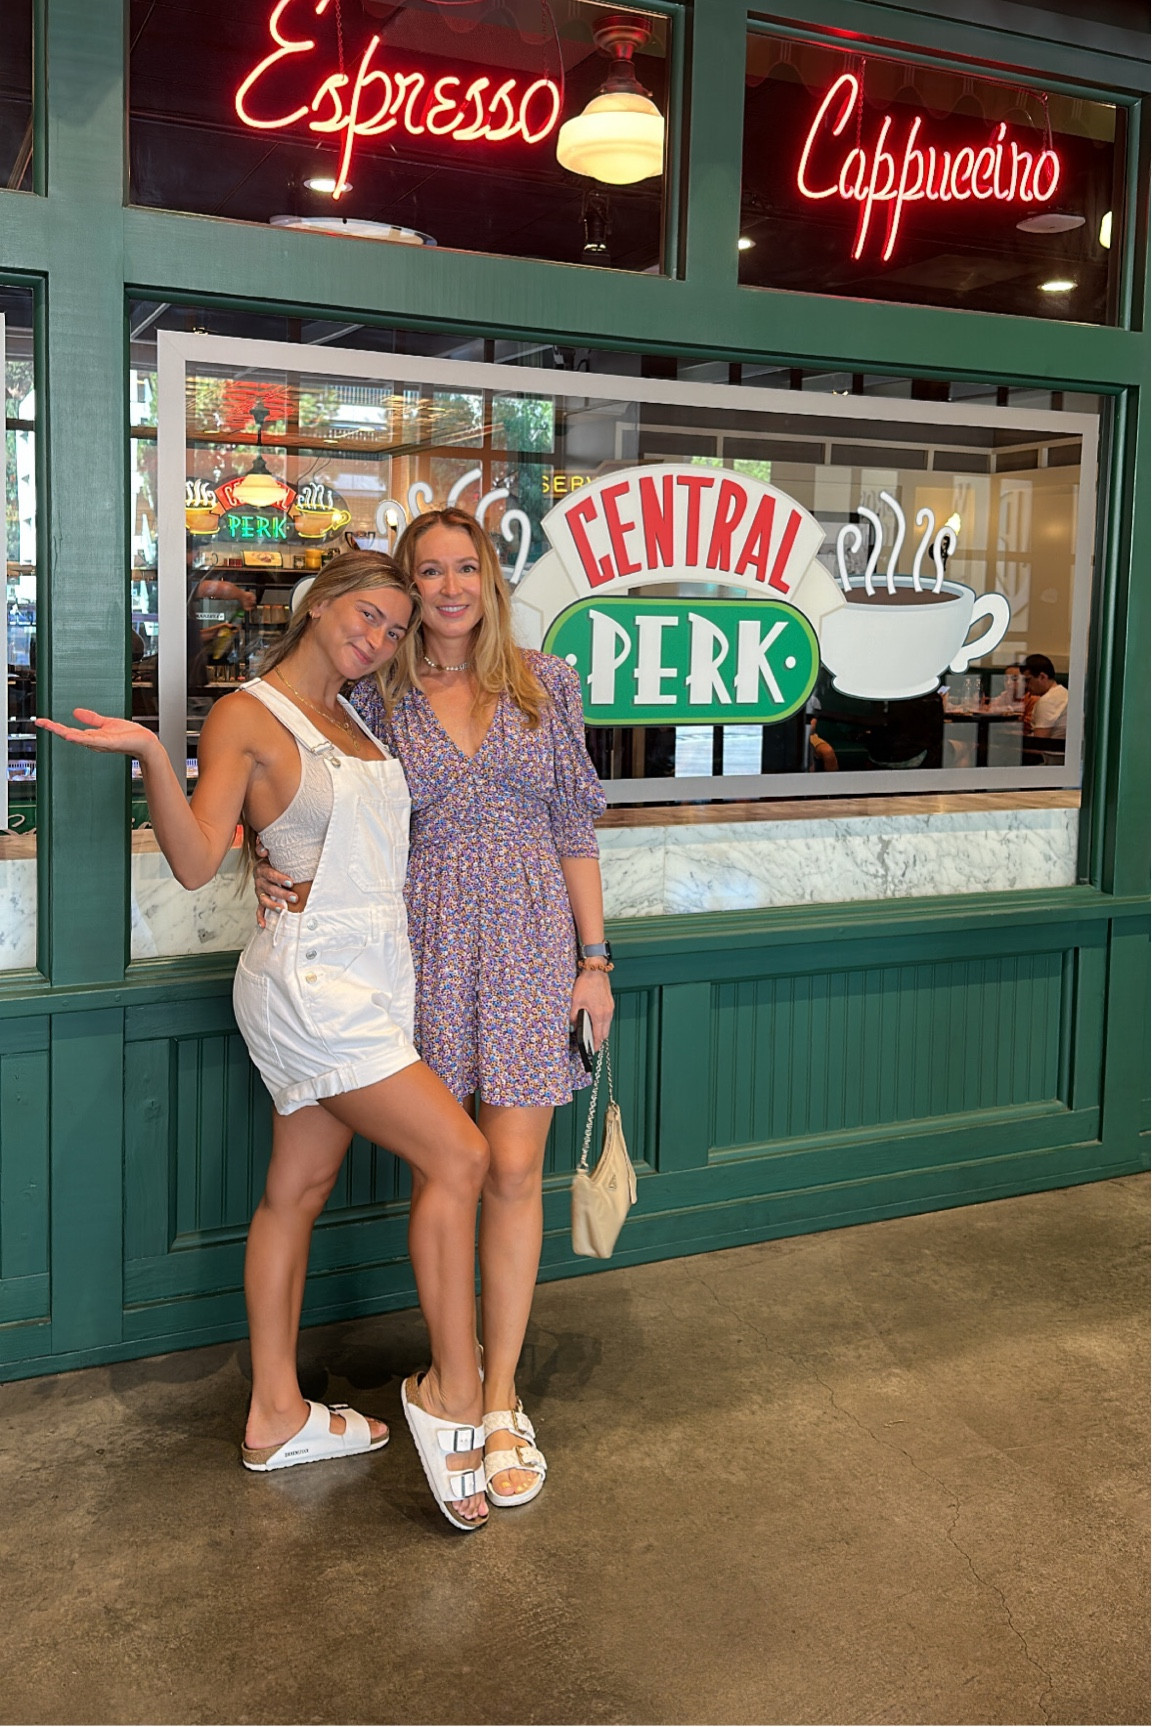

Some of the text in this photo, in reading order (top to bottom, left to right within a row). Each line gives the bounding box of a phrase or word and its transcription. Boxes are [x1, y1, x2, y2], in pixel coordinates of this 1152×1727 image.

[234, 0, 561, 201] Espresso
[797, 73, 1061, 262] Cappuccino
[227, 513, 287, 540] PERK
[564, 473, 803, 595] CENTRAL
[586, 608, 790, 706] PERK
